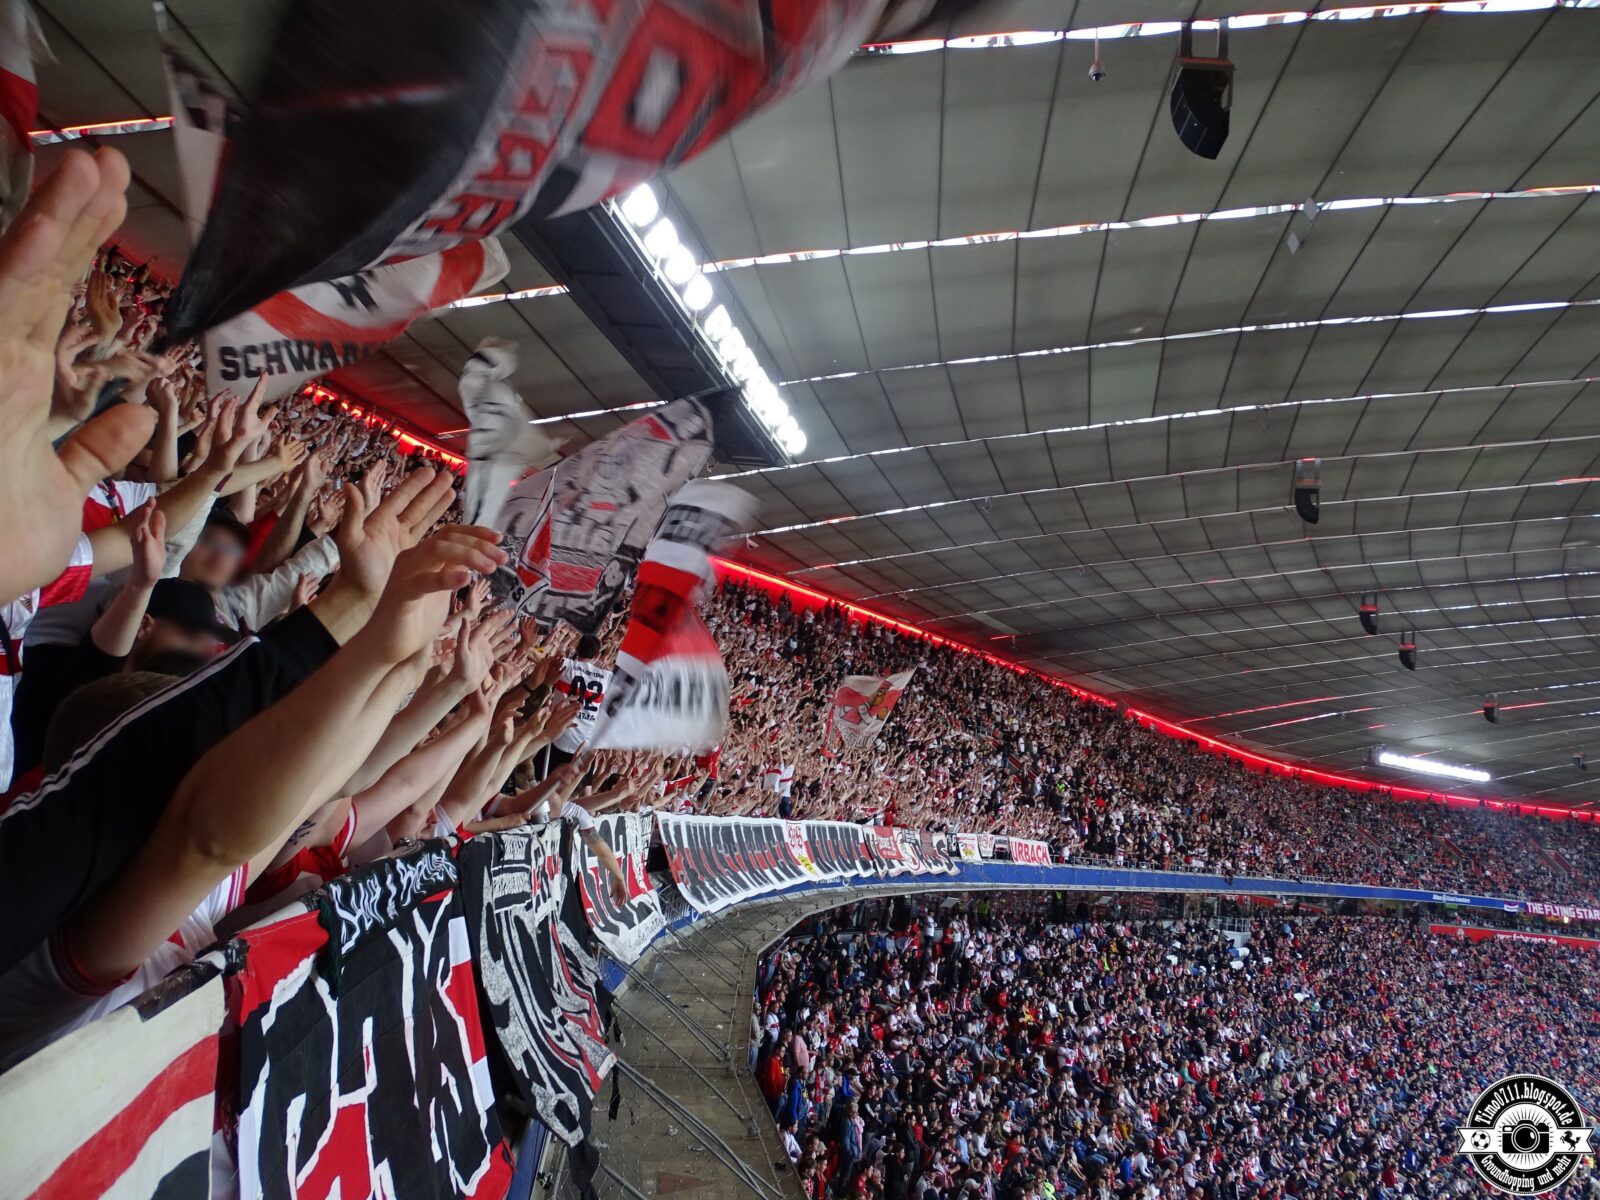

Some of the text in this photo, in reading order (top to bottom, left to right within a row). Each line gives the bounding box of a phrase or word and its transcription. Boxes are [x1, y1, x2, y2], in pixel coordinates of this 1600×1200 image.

[1011, 840, 1051, 865] URBACH
[1526, 901, 1600, 921] THE FLYING STAR
